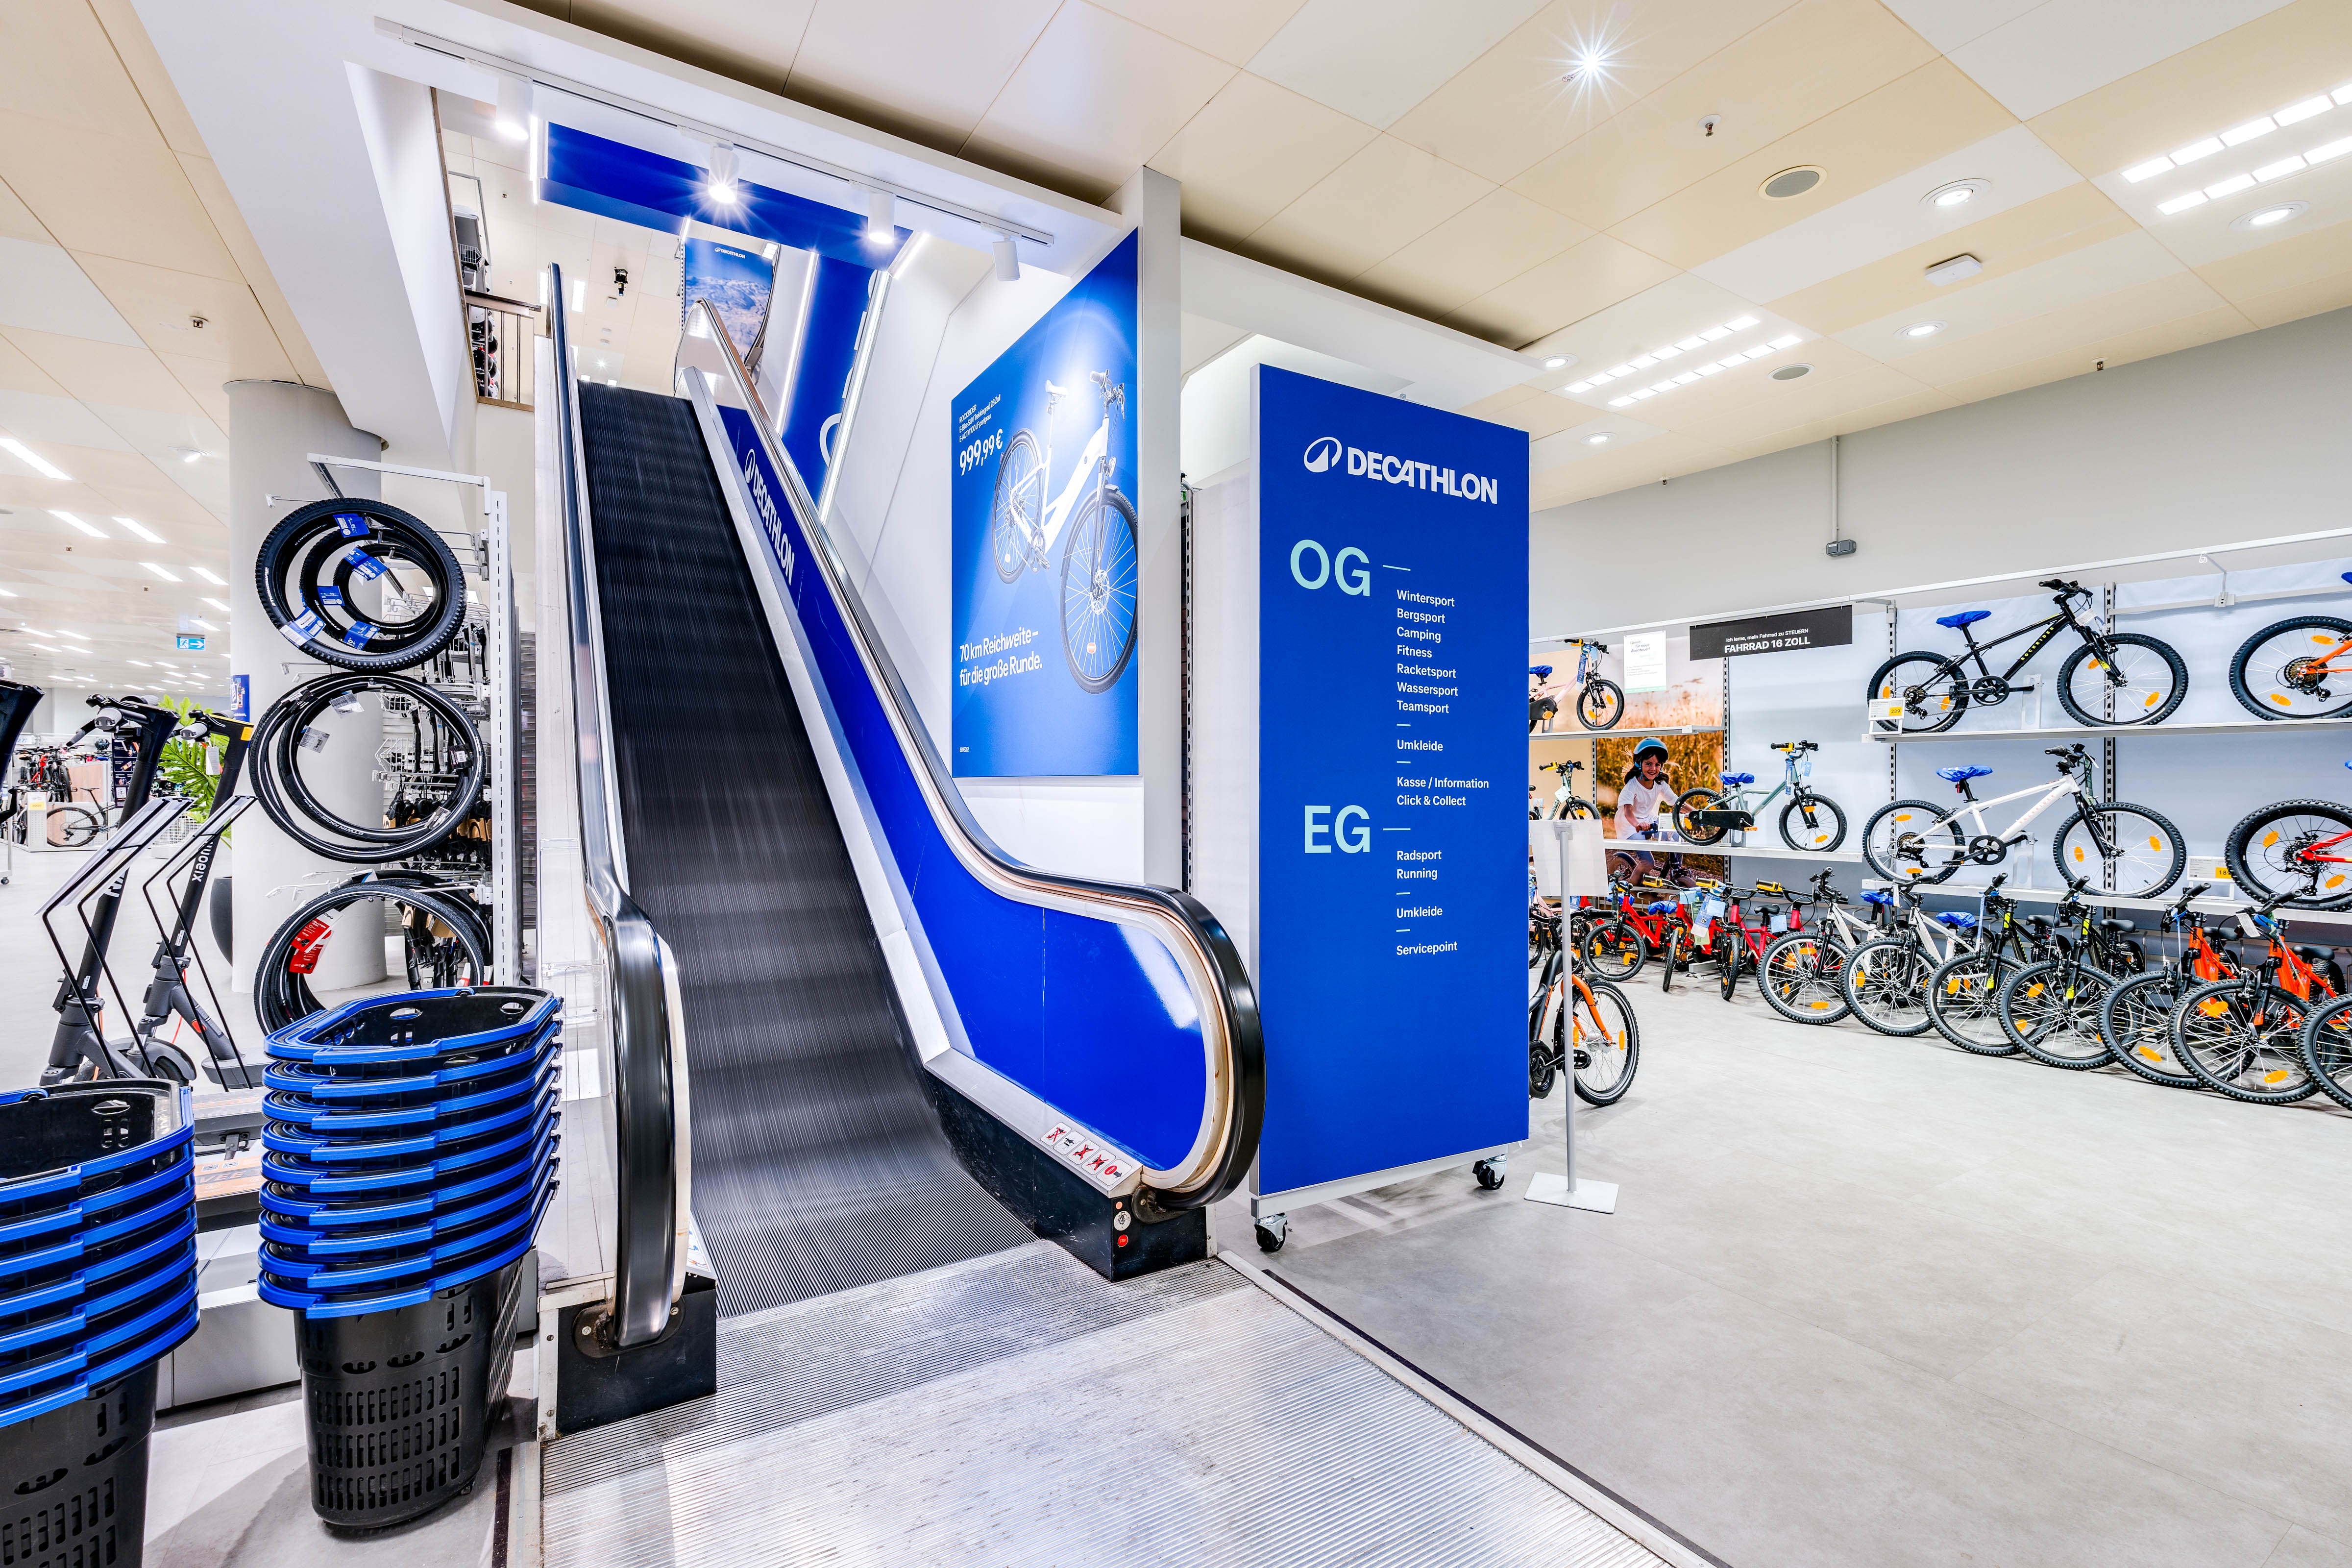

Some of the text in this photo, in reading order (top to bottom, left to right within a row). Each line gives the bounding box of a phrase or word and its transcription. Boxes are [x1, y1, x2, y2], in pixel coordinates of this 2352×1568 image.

[721, 248, 746, 259] DECATHLON
[990, 398, 995, 408] 28
[959, 404, 977, 423] ROCKRIDER
[1348, 447, 1497, 504] DECATHLON
[754, 464, 795, 586] DECATHLON
[1291, 540, 1370, 596] OG
[1397, 590, 1454, 607] Wintersport
[1397, 608, 1445, 623] Bergsport
[1397, 627, 1441, 643] Camping
[959, 643, 970, 662] 70
[970, 642, 982, 660] km
[983, 627, 1031, 656] Reichweite
[1397, 645, 1432, 658] Fitness
[1724, 637, 1811, 653] FAHRRAD 16 ZOLL
[2020, 627, 2054, 661] ROCKRIDER
[959, 650, 1043, 686] für die große Runde.
[1397, 663, 1456, 679] Racketsport
[1397, 682, 1458, 697] Wassersport
[1397, 700, 1449, 714] Teamsport
[1397, 740, 1443, 751] Umkleide
[1397, 777, 1489, 788] Kasse / Information
[1397, 795, 1466, 806] Click & Collect
[1305, 805, 1370, 853] EG
[1397, 850, 1442, 862] Radsport
[1397, 868, 1437, 880] Running
[1397, 906, 1443, 918] Umkleide
[1396, 941, 1457, 955] Servicepoint
[1106, 1166, 1116, 1174] STOP
